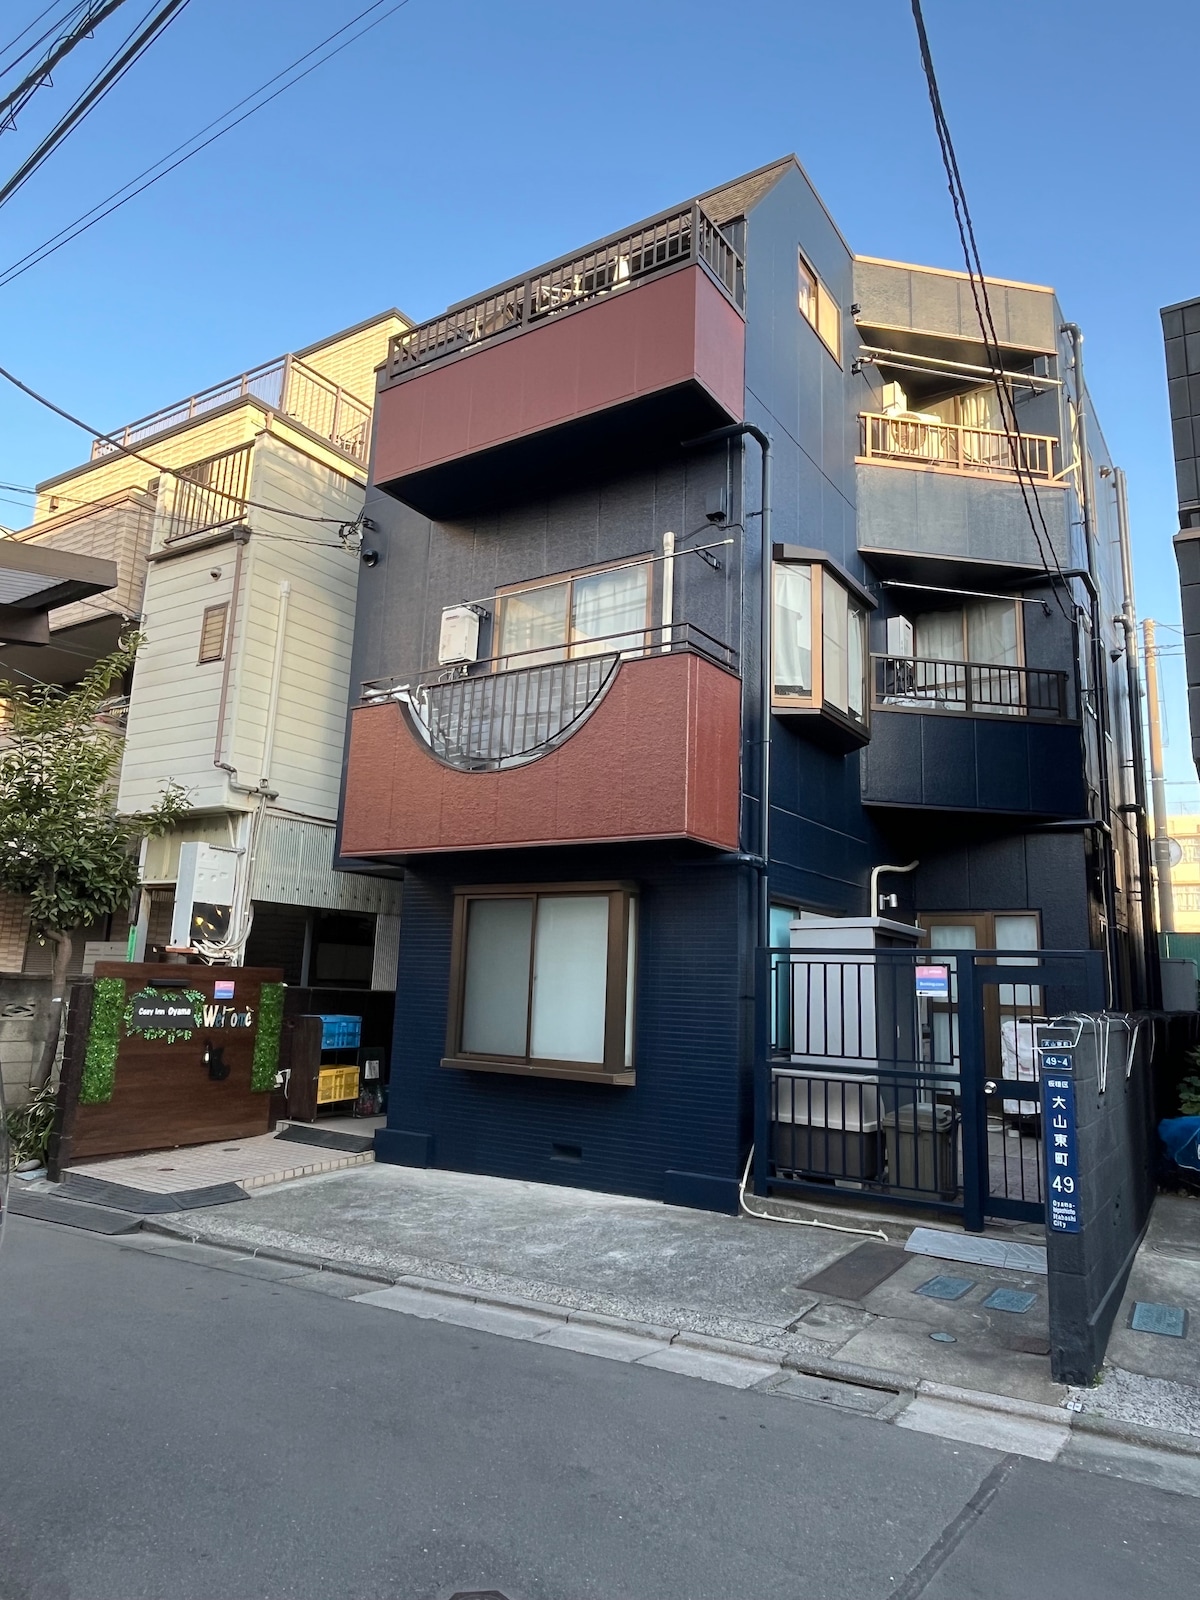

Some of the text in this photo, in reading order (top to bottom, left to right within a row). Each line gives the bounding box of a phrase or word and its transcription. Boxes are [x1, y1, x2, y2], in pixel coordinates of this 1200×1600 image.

[138, 1006, 192, 1017] Cozy Inn Oyama
[1045, 1056, 1069, 1067] 49-4
[1051, 1095, 1069, 1167] 大山東町
[1052, 1175, 1075, 1194] 49
[1053, 1220, 1067, 1229] City
